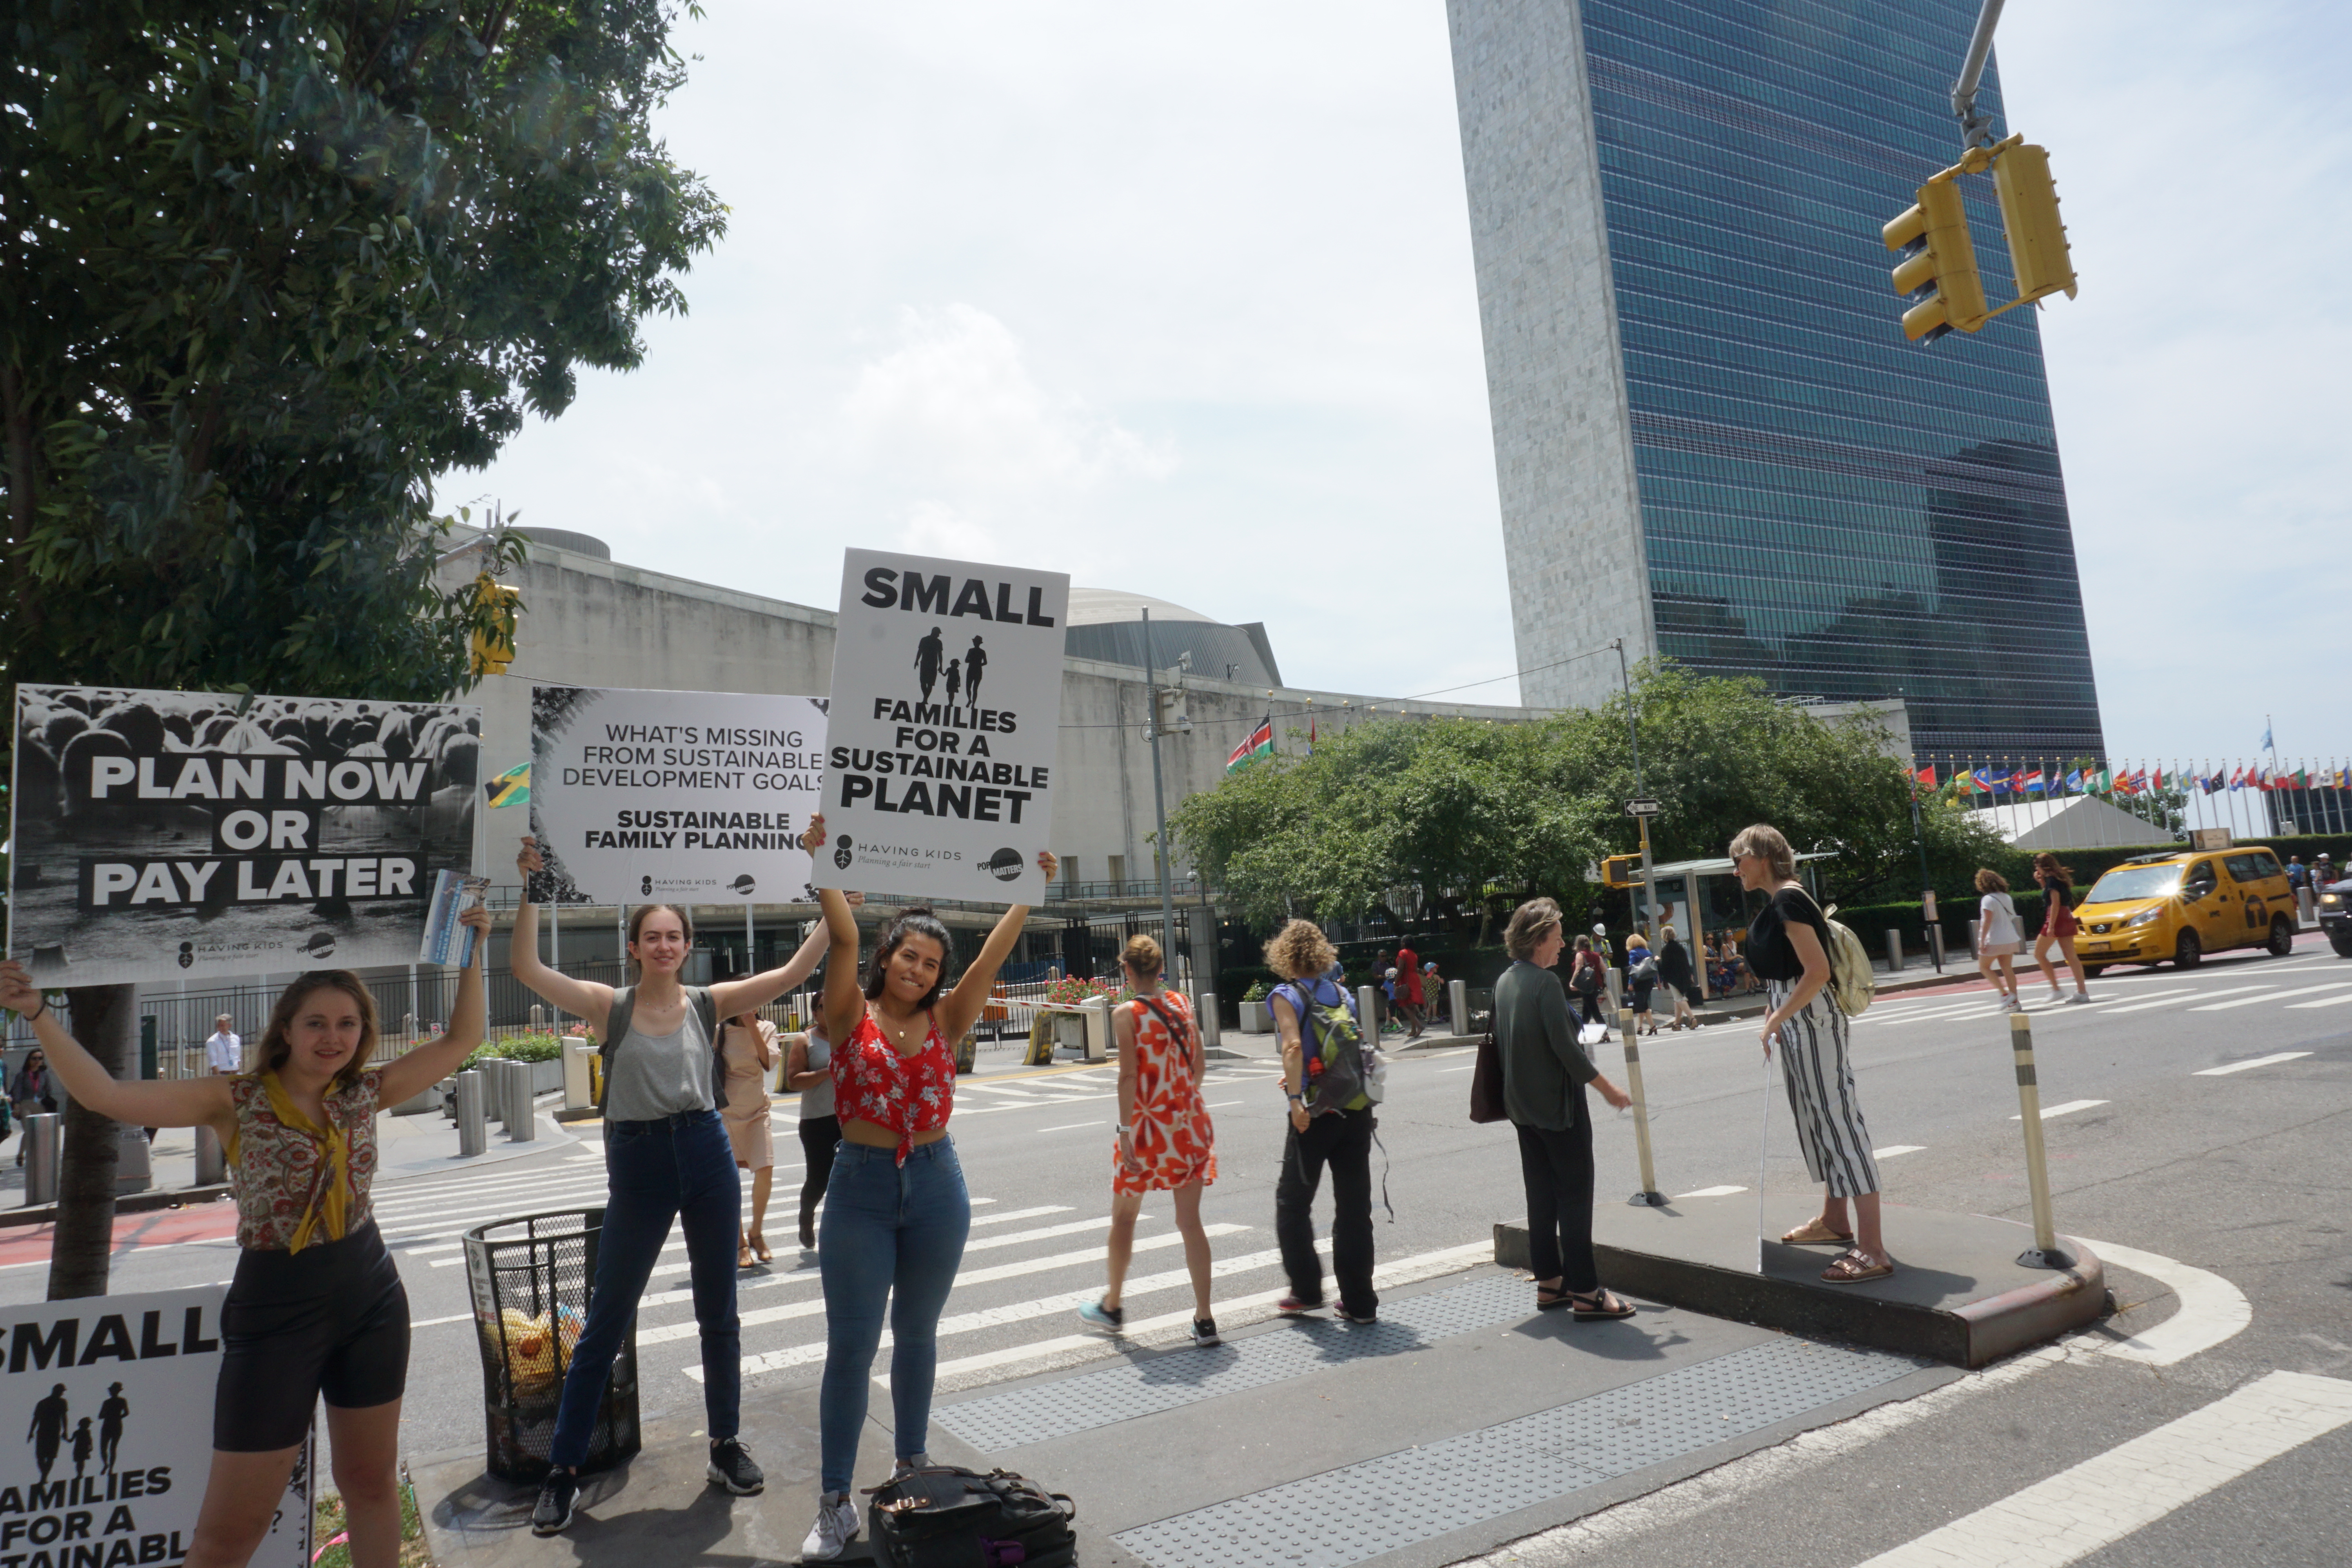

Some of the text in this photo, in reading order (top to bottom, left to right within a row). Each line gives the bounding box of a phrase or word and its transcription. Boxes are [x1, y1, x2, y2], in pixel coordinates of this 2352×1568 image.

[861, 568, 1054, 628] SMALL
[874, 698, 1016, 733] FAMILIES
[606, 724, 802, 748] WHAT'S MISSING
[896, 727, 990, 757] FOR A
[584, 746, 822, 769] FROM SUSTAINABLE
[830, 747, 1049, 789] SUSTAINABLE
[92, 757, 427, 800] PLAN NOW
[564, 768, 745, 789] DEVELOPMENT
[841, 774, 1031, 824] PLANET
[221, 810, 309, 850] OR
[617, 810, 789, 830] SUSTAINABLE
[586, 831, 677, 849] FAMILY
[858, 843, 961, 860] HAVING KIDS
[858, 855, 890, 867] Planning
[897, 859, 913, 868] fair
[993, 864, 1023, 877] MATTERS
[93, 858, 415, 905] PAY LATER
[198, 943, 249, 953] HAVING
[0, 1307, 219, 1374] MALL
[0, 1505, 136, 1551] FOR A
